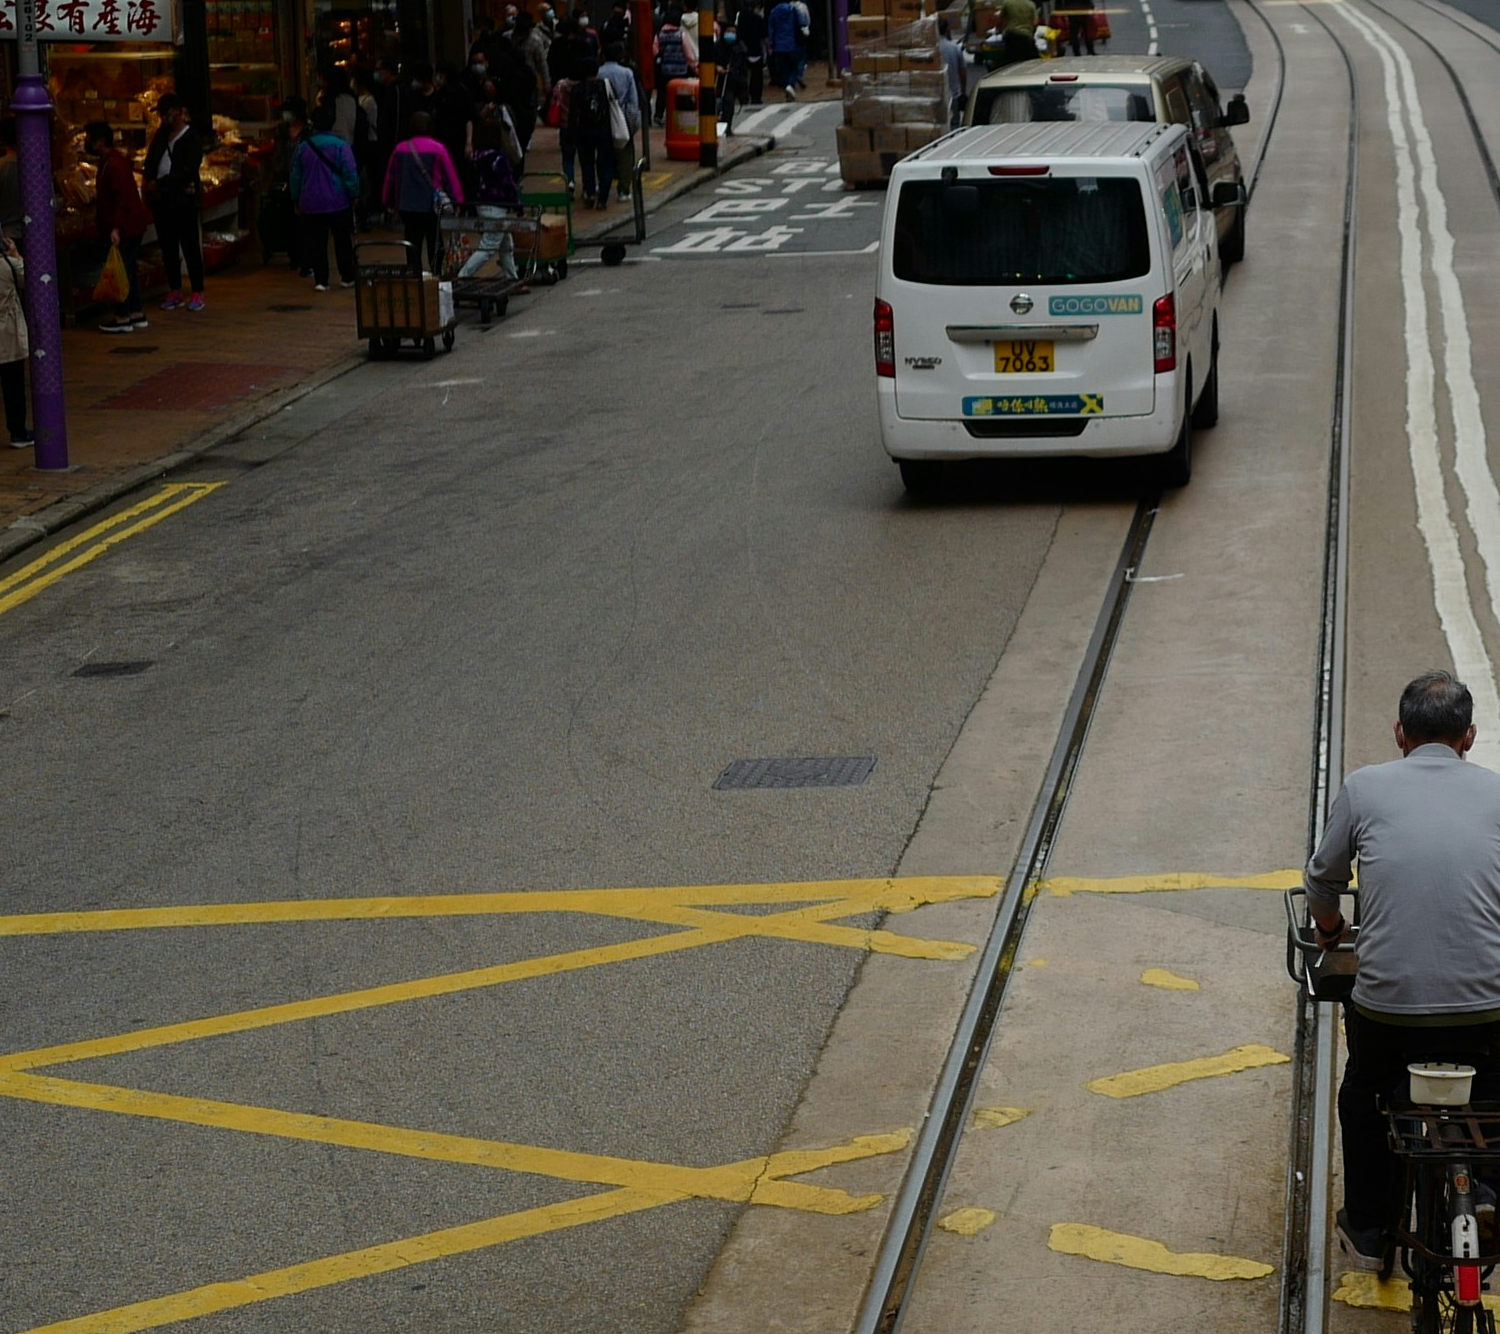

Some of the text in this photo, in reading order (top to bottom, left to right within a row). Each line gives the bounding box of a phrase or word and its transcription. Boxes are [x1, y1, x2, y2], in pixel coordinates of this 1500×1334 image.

[683, 194, 879, 224] 巴士
[649, 224, 805, 254] 站
[1052, 296, 1140, 313] GOGOVAN
[1011, 341, 1036, 357] UV
[999, 356, 1050, 373] 7063
